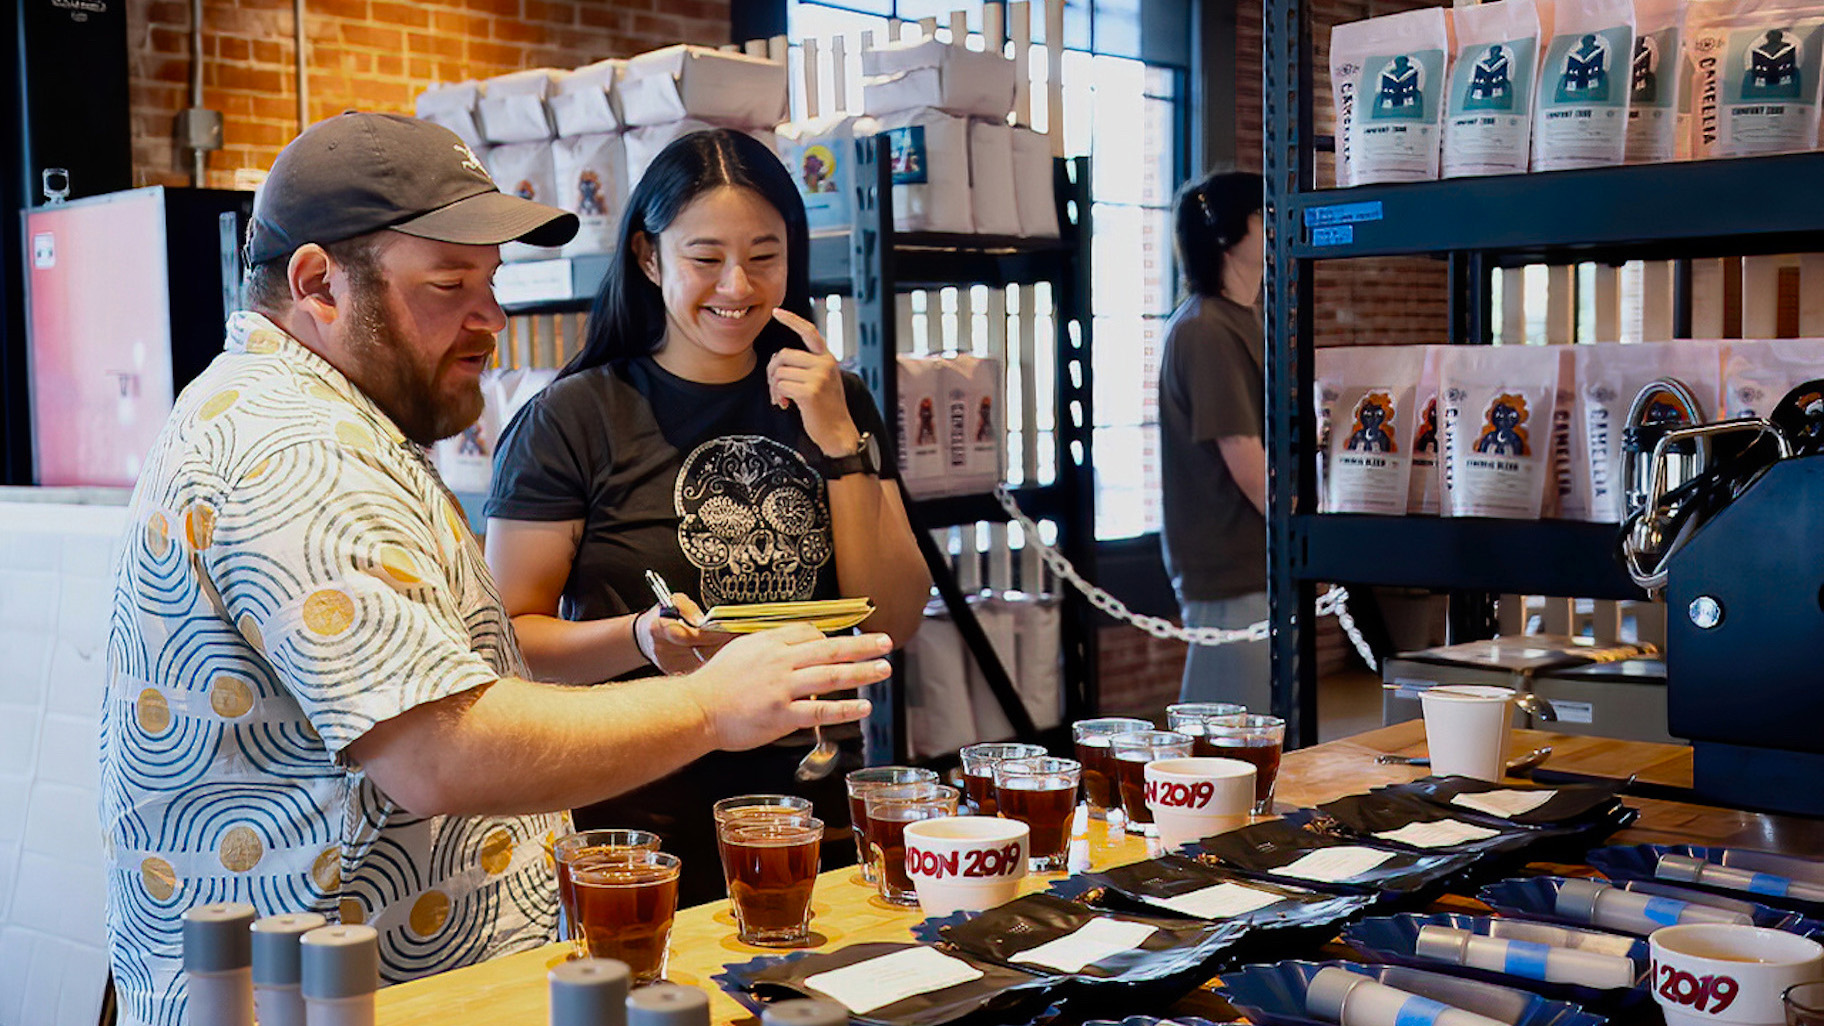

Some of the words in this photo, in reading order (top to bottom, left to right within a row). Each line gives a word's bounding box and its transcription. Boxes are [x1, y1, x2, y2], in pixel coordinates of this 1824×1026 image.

[1698, 56, 1717, 145] CAMELLIA
[1554, 409, 1572, 495] CAMELLIA
[1590, 409, 1609, 497] CAMELLIA
[1144, 780, 1157, 803] N
[1160, 781, 1215, 809] 2019
[963, 842, 1021, 877] 2019
[1659, 964, 1739, 1015] 2019
